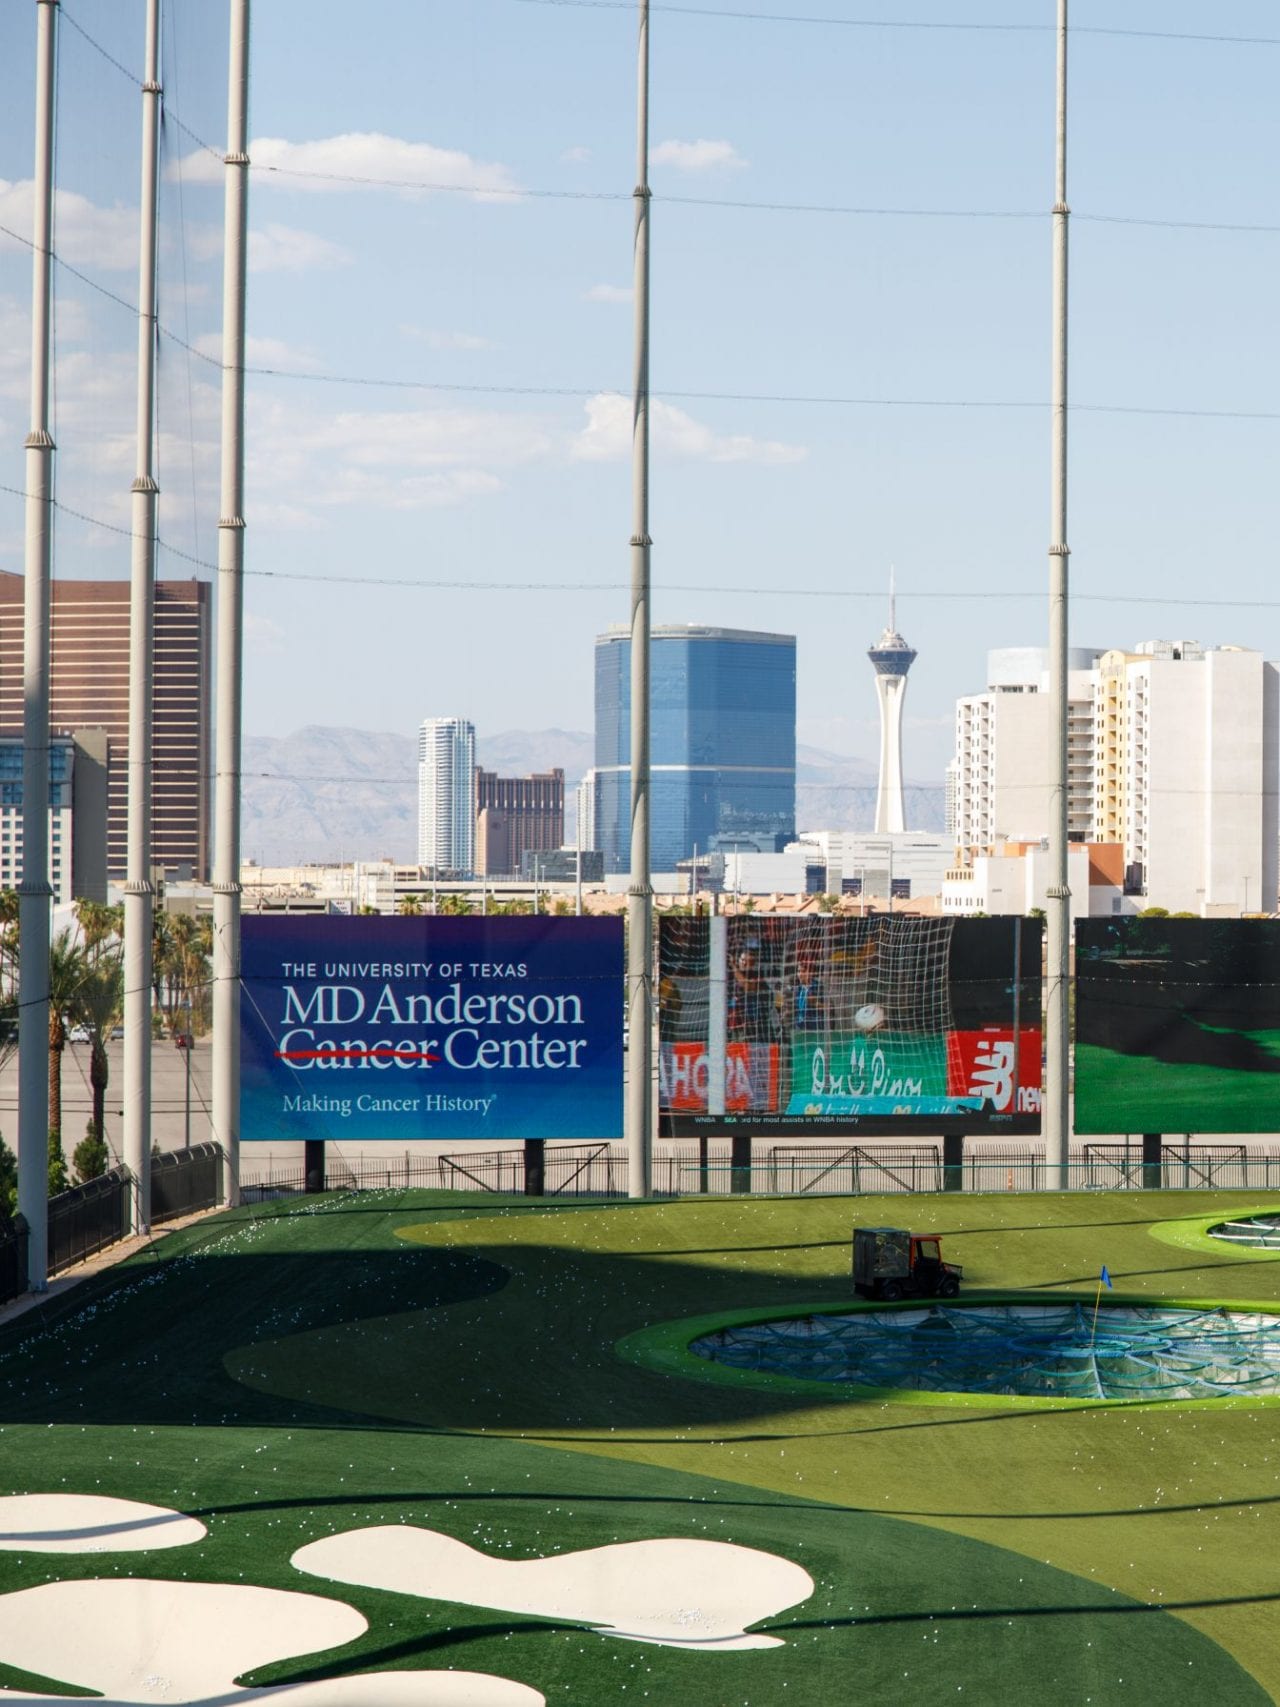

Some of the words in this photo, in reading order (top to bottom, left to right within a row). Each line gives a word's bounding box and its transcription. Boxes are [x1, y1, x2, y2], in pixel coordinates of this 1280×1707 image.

[282, 963, 317, 977] THE
[325, 963, 433, 977] UNIVERSITY
[439, 963, 463, 977] OF
[469, 963, 528, 977] TEXAS
[280, 985, 364, 1024] MD
[367, 983, 585, 1025] Anderson
[279, 1028, 438, 1069] Cancer
[444, 1028, 587, 1069] Center
[282, 1094, 352, 1116] Making
[357, 1095, 420, 1112] Cancer
[836, 1116, 859, 1125] history
